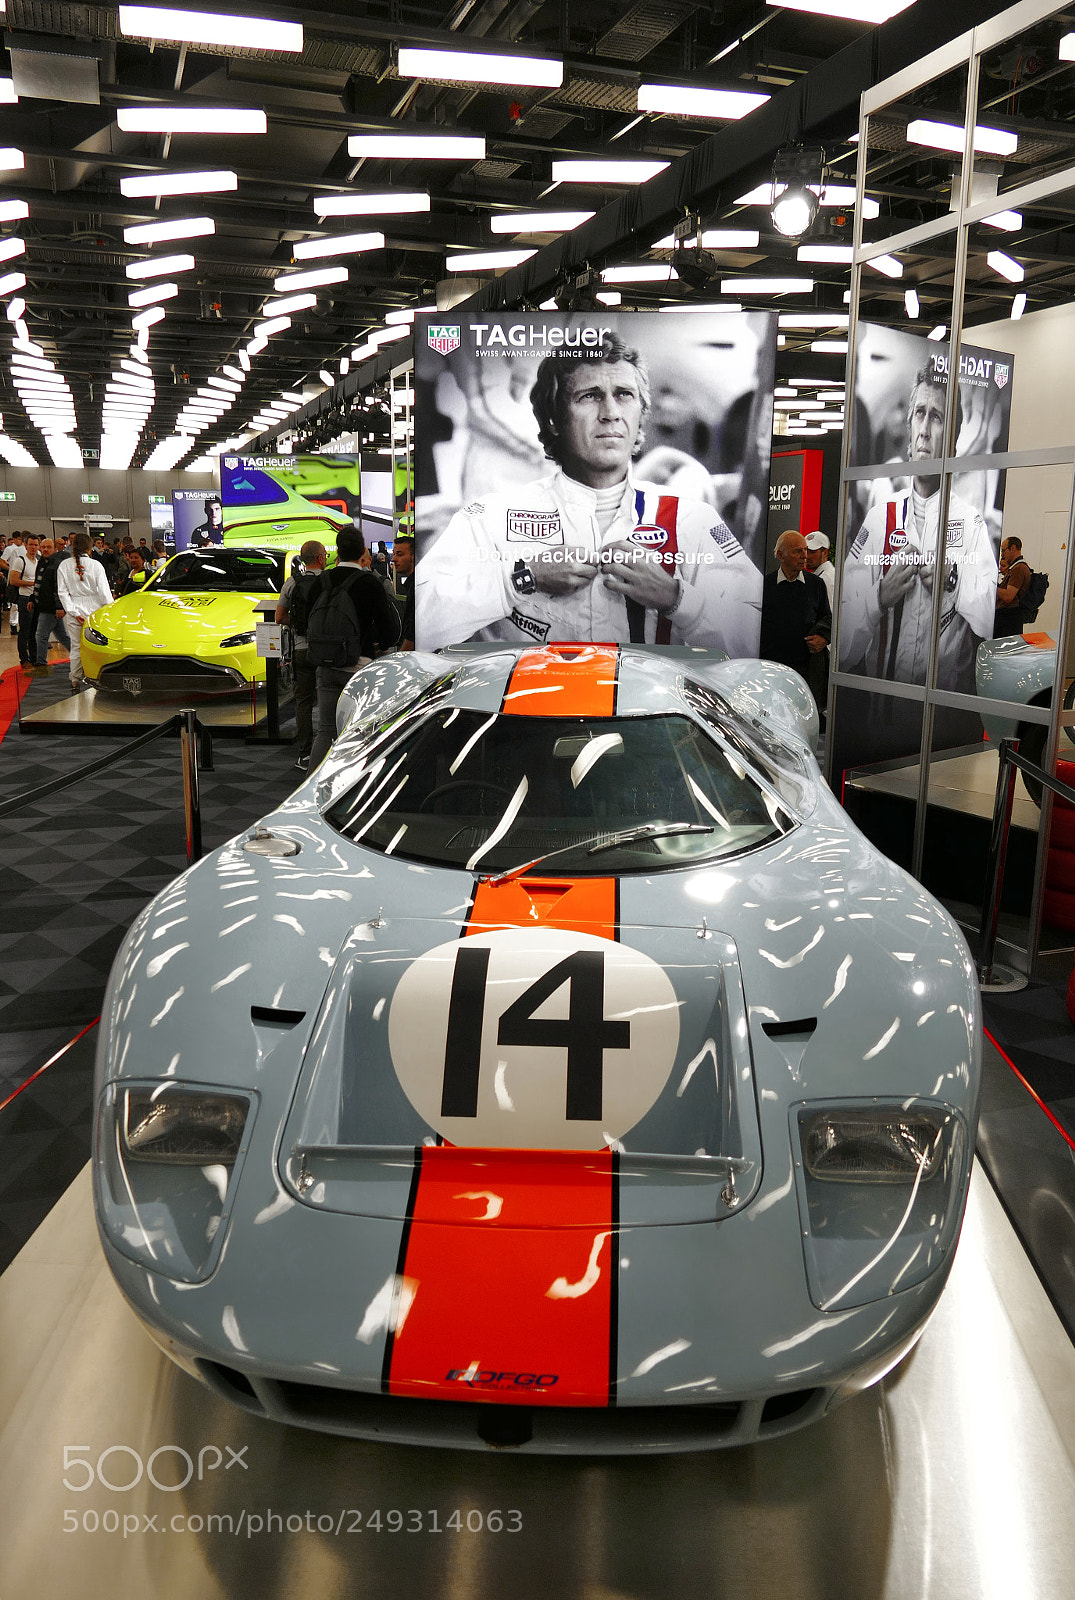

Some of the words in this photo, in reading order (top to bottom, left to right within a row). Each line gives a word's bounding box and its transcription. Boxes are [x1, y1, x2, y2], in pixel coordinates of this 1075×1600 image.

[430, 327, 458, 338] TAG
[429, 338, 459, 353] HEUER
[475, 350, 499, 358] SWISS
[559, 350, 583, 358] SINCE
[585, 350, 603, 358] 1860
[514, 521, 557, 537] HEUER
[632, 531, 666, 543] Gulf
[440, 947, 631, 1122] 14
